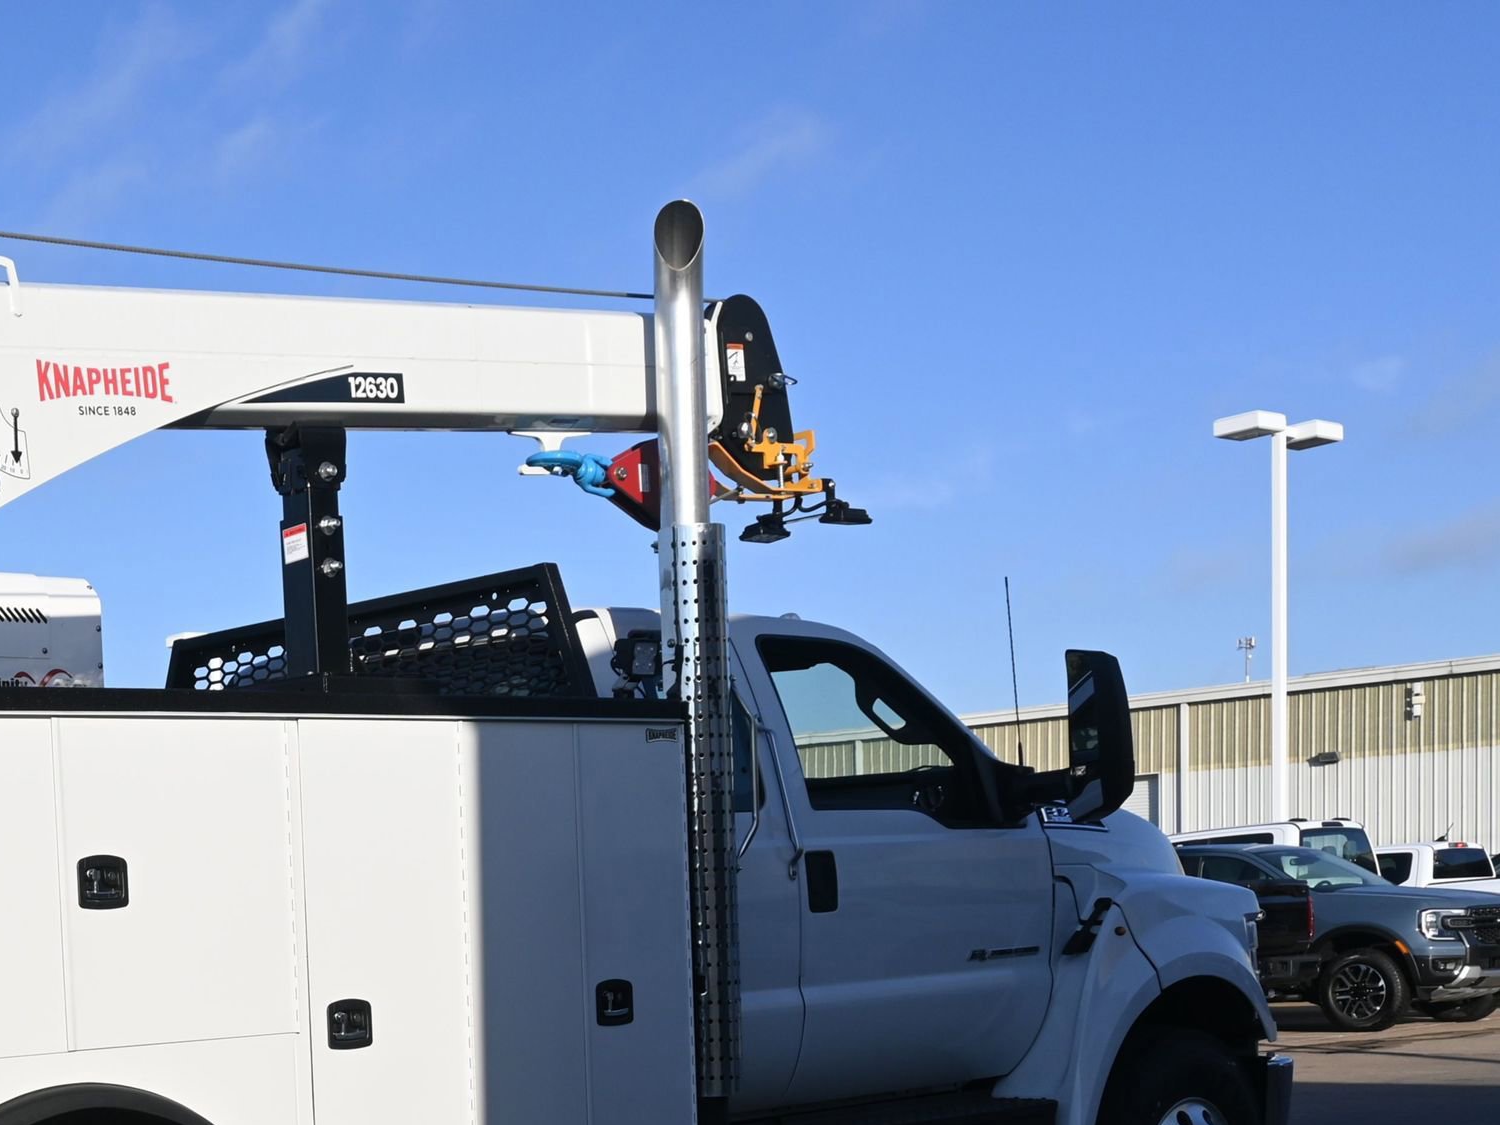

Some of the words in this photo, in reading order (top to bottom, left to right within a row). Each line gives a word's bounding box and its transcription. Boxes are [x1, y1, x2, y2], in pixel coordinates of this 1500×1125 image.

[36, 358, 173, 403] KNAPHEIDE
[348, 376, 398, 399] 12630
[78, 405, 110, 416] SINCE
[113, 405, 137, 416] 1848
